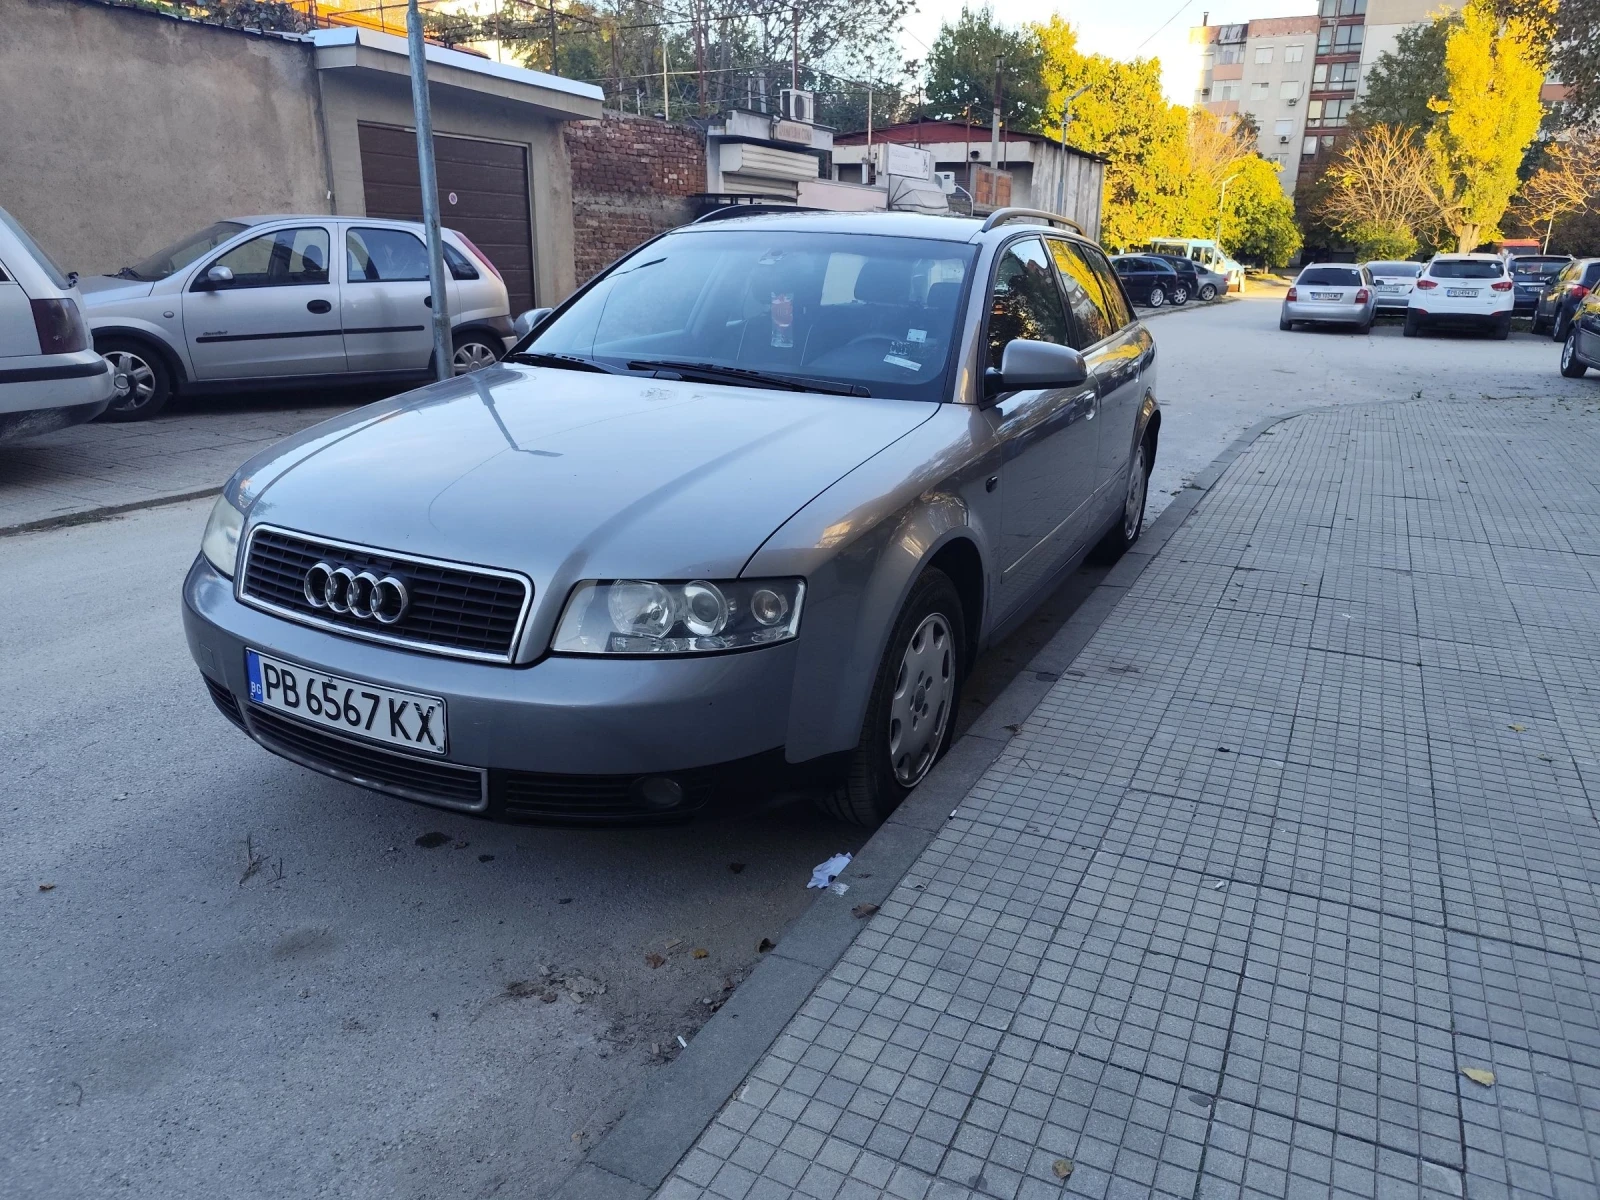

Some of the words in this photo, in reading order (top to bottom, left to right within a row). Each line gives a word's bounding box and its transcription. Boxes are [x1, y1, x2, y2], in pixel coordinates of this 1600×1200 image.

[250, 681, 262, 694] BG
[263, 662, 300, 709] PB
[306, 678, 381, 731] 6567
[388, 697, 437, 746] KX
